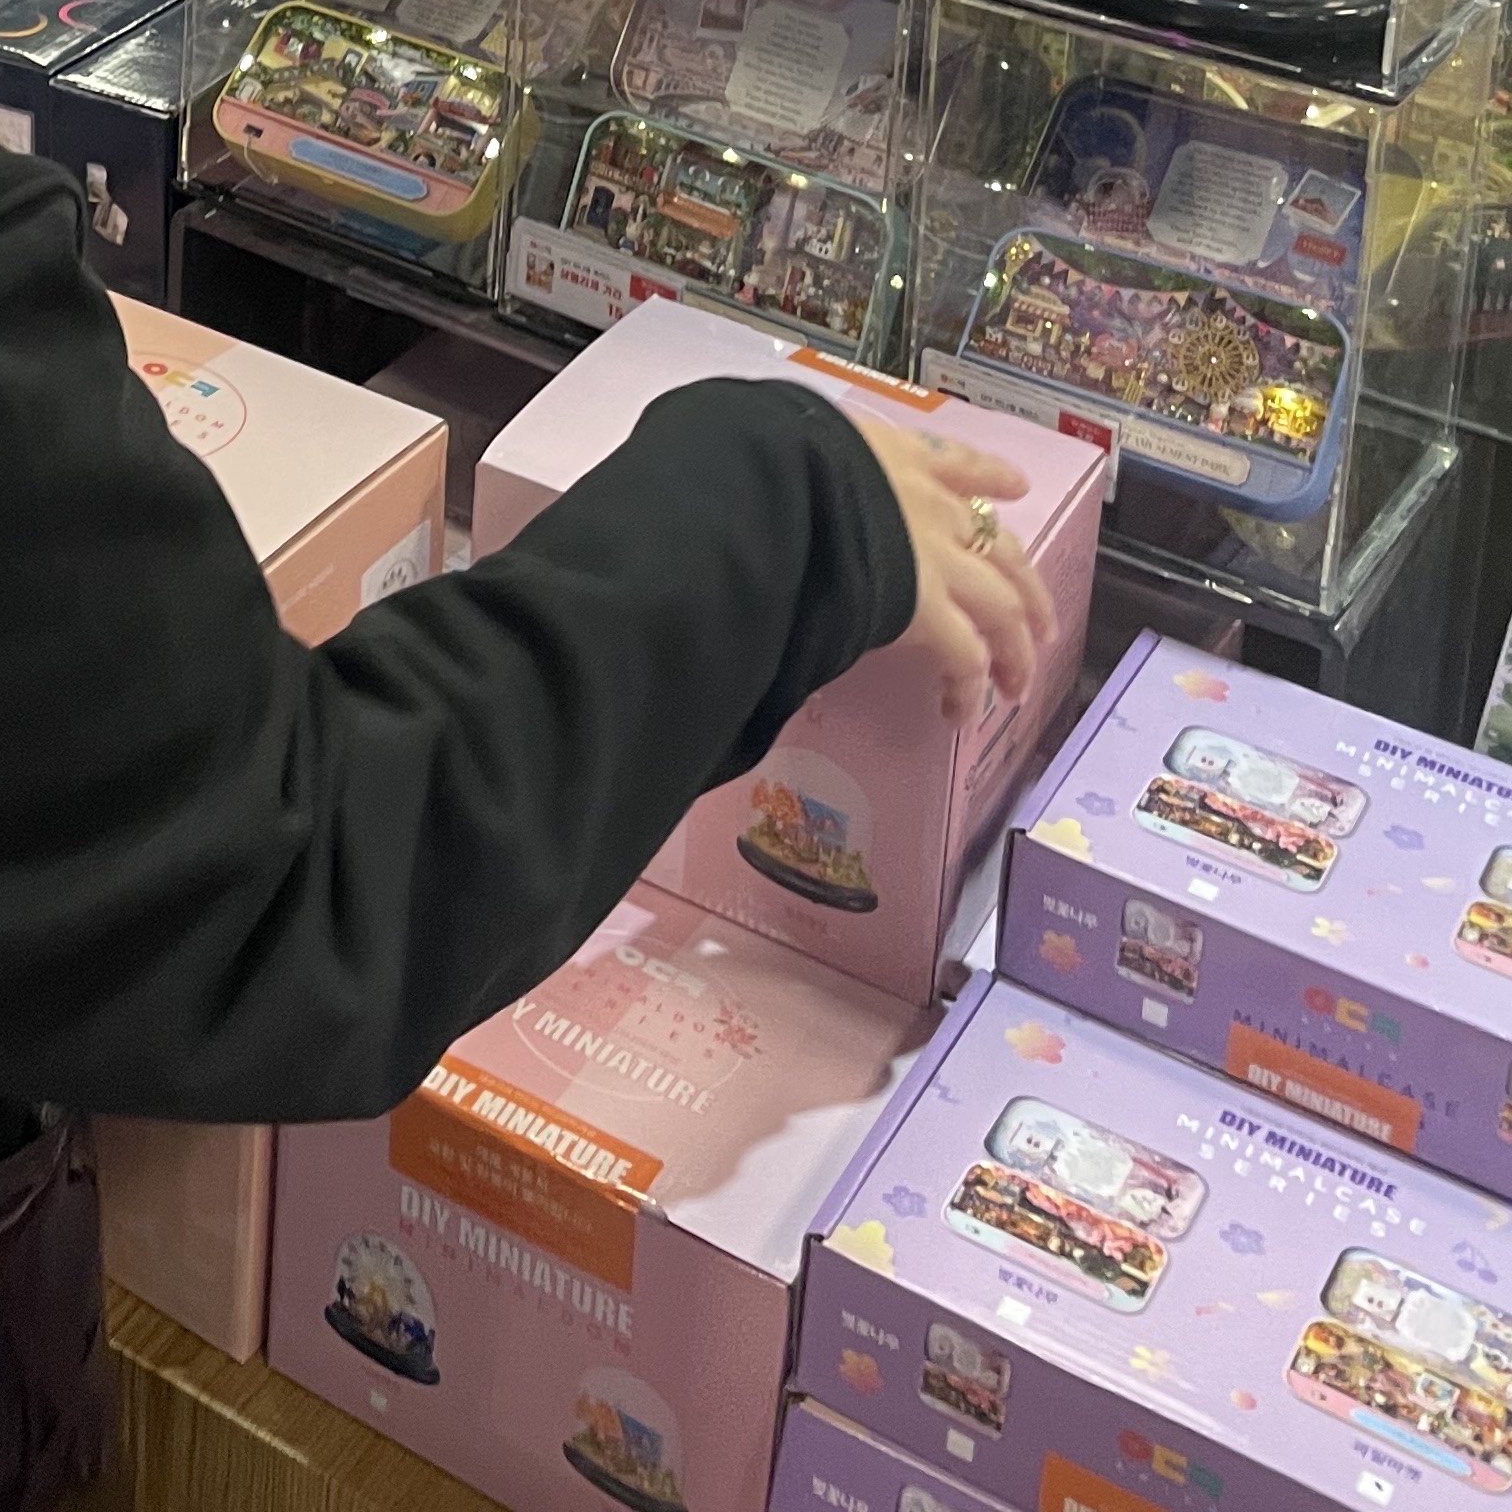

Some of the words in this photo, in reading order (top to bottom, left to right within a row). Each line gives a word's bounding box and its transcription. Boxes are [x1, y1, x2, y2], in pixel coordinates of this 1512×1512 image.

[1374, 738, 1413, 761] DIY
[534, 1009, 717, 1117] MINIATURE
[421, 1064, 478, 1106] DIY
[470, 1088, 633, 1184] MINIATURE
[1218, 1108, 1263, 1137] DIY
[1264, 1129, 1398, 1201] MINIATURE
[399, 1184, 451, 1234] DIY
[457, 1215, 633, 1340] MINIATURE
